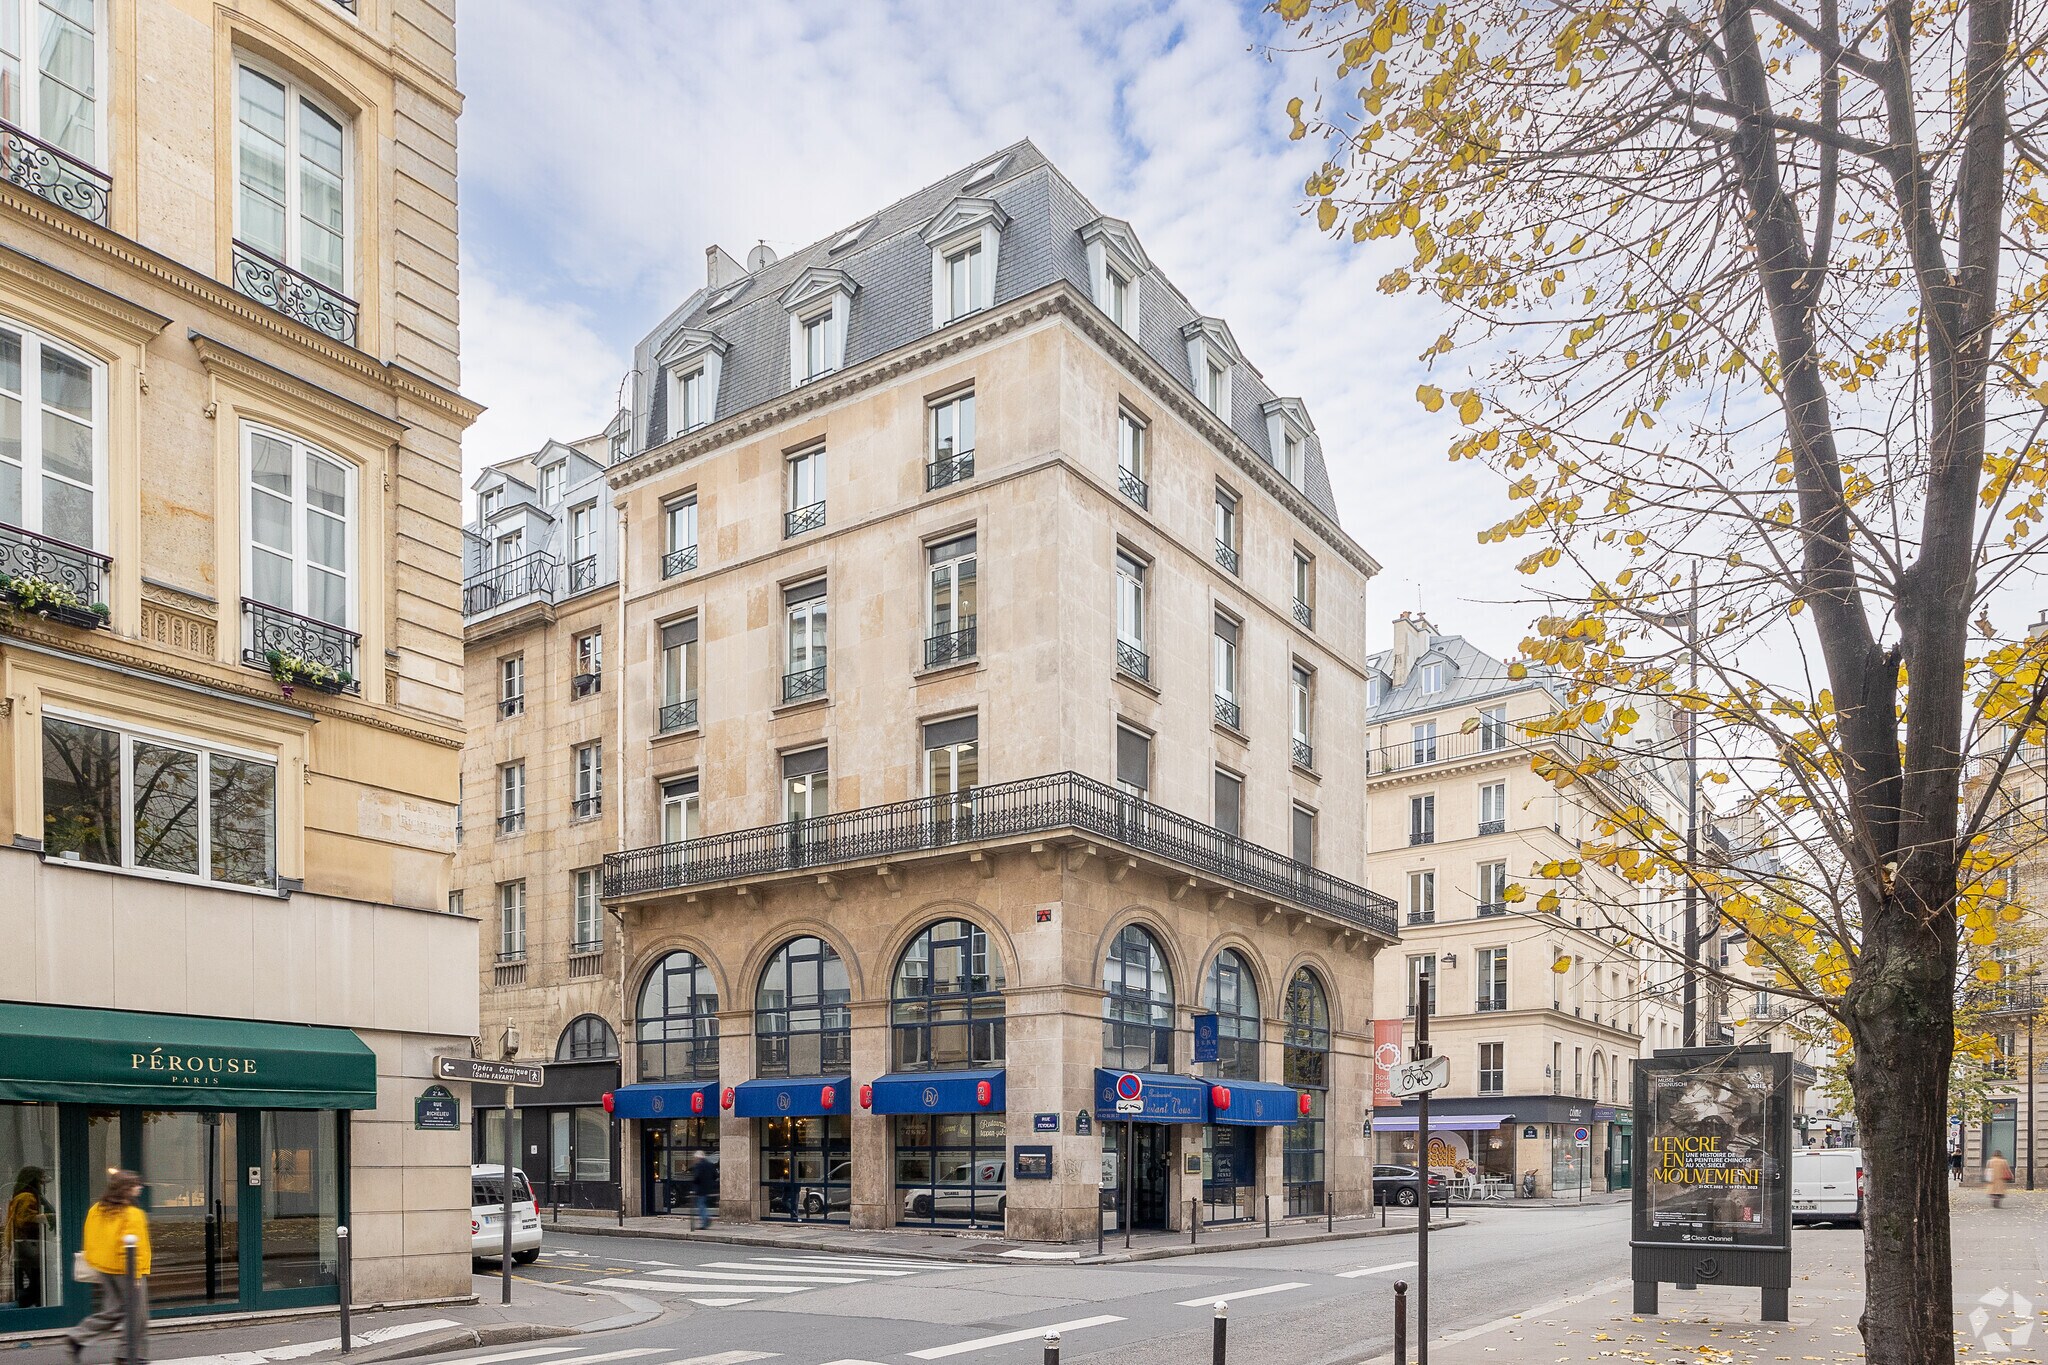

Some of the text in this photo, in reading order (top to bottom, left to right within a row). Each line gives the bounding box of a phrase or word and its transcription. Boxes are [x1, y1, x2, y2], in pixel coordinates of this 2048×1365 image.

[131, 1047, 257, 1074] PÉROUSE
[472, 1063, 528, 1076] Opéra Comique
[472, 1071, 516, 1081] (Salle FAVART)
[172, 1076, 219, 1084] PARIS
[1654, 1136, 1721, 1152] L'ENCRE
[1663, 1152, 1685, 1168] EN
[1653, 1167, 1760, 1185] MOUVEMENT
